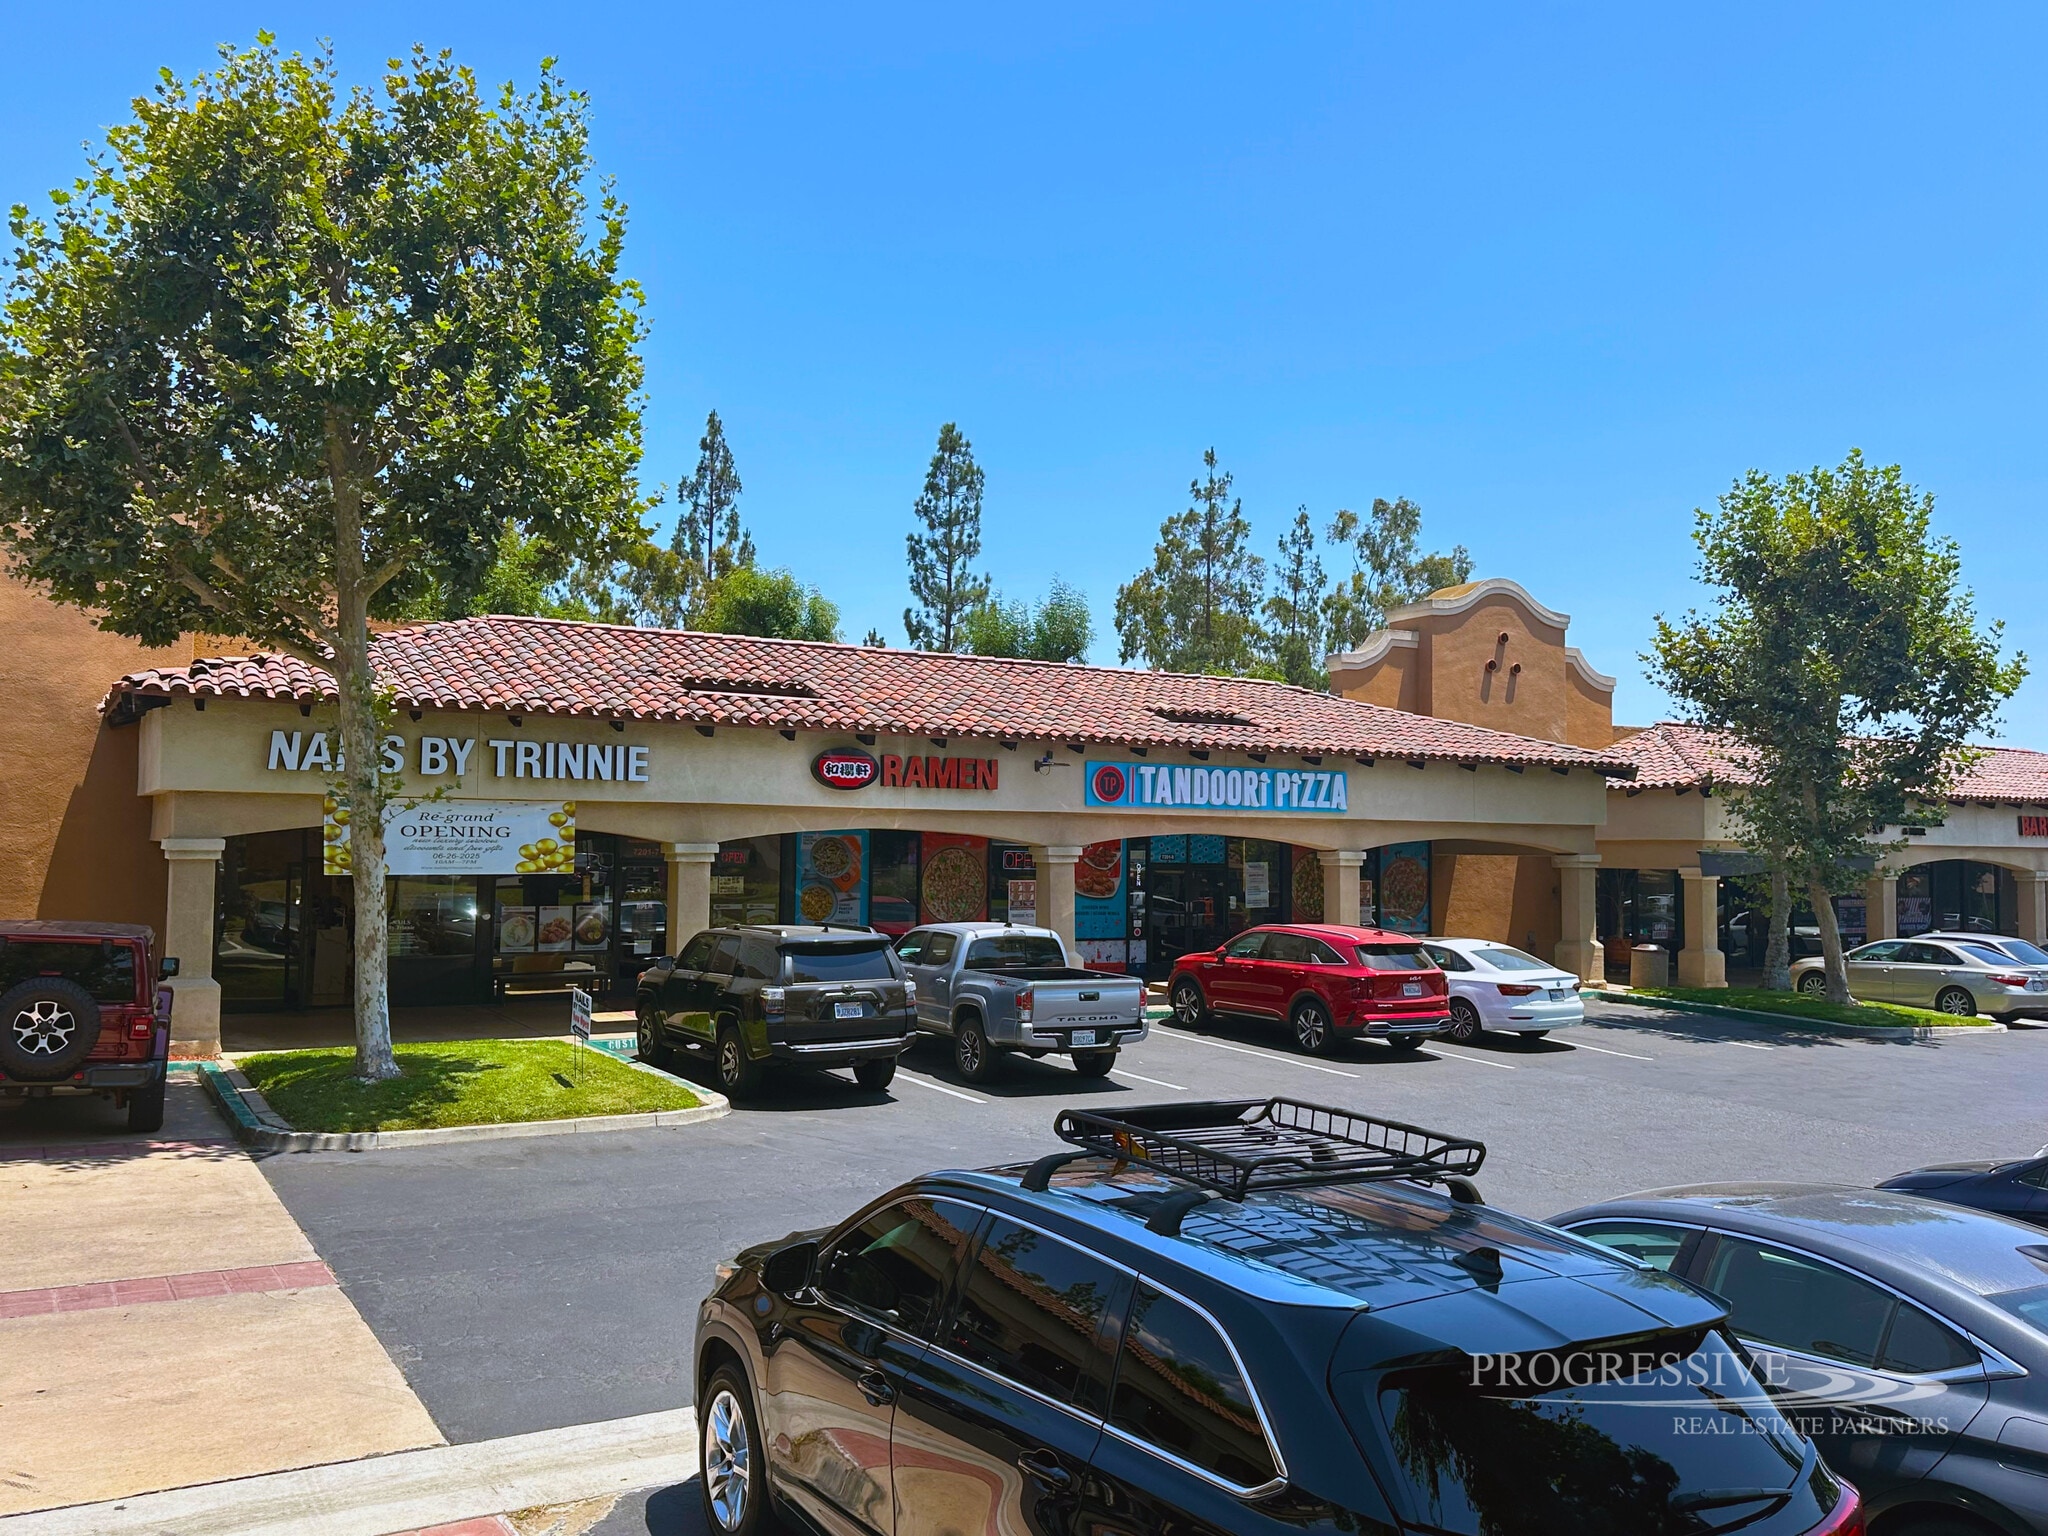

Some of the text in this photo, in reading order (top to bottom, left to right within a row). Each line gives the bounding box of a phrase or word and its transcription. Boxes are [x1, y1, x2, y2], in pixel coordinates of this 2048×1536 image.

[420, 736, 476, 777] BY
[488, 739, 649, 782] TRINNIE
[880, 754, 998, 791] RAMEN
[1103, 776, 1117, 792] TP
[418, 812, 495, 824] Re-grand
[400, 825, 511, 838] OPENING
[1005, 852, 1036, 868] OPE
[608, 1038, 637, 1050] CUST
